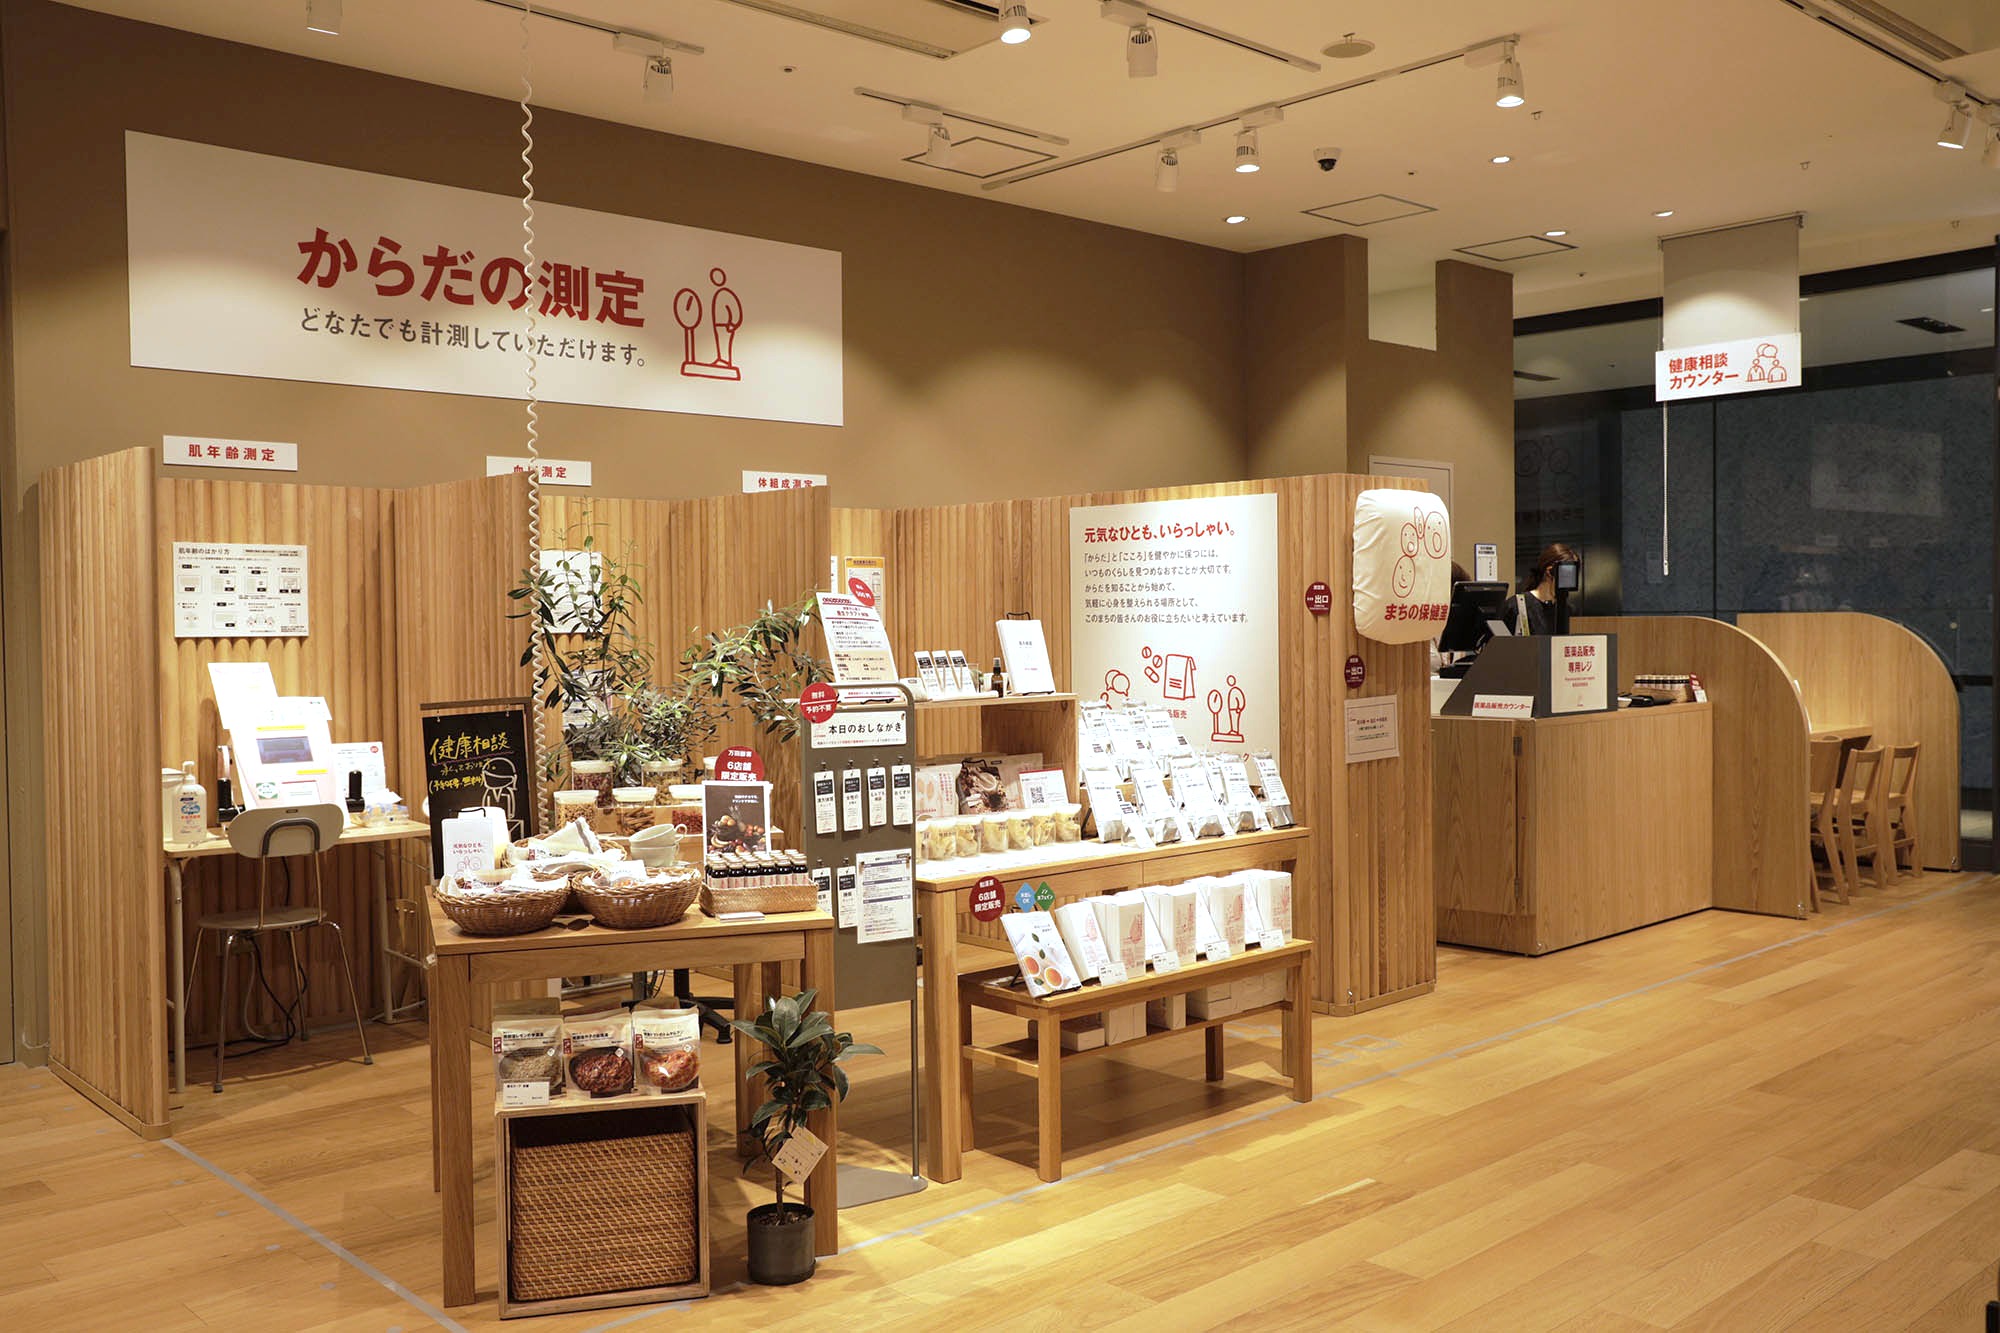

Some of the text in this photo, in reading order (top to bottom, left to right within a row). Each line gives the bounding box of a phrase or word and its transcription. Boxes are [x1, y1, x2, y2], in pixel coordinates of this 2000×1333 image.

[297, 227, 645, 328] からだの測定
[300, 307, 646, 368] どなたでも計測していただけます。
[1668, 352, 1729, 374] 健康相談
[1669, 370, 1740, 391] カウンター
[188, 444, 275, 462] 肌年齢測定
[1084, 520, 1235, 544] 元気なひとも、いらっしゃい。
[1384, 603, 1449, 622] まちの保健室
[1564, 645, 1595, 658] 医薬品販売
[1568, 661, 1592, 673] 専用レジ
[1474, 702, 1531, 710] 医薬品販売カウンター
[828, 723, 902, 735] 本日のおしながき
[430, 731, 511, 764] 健康相談
